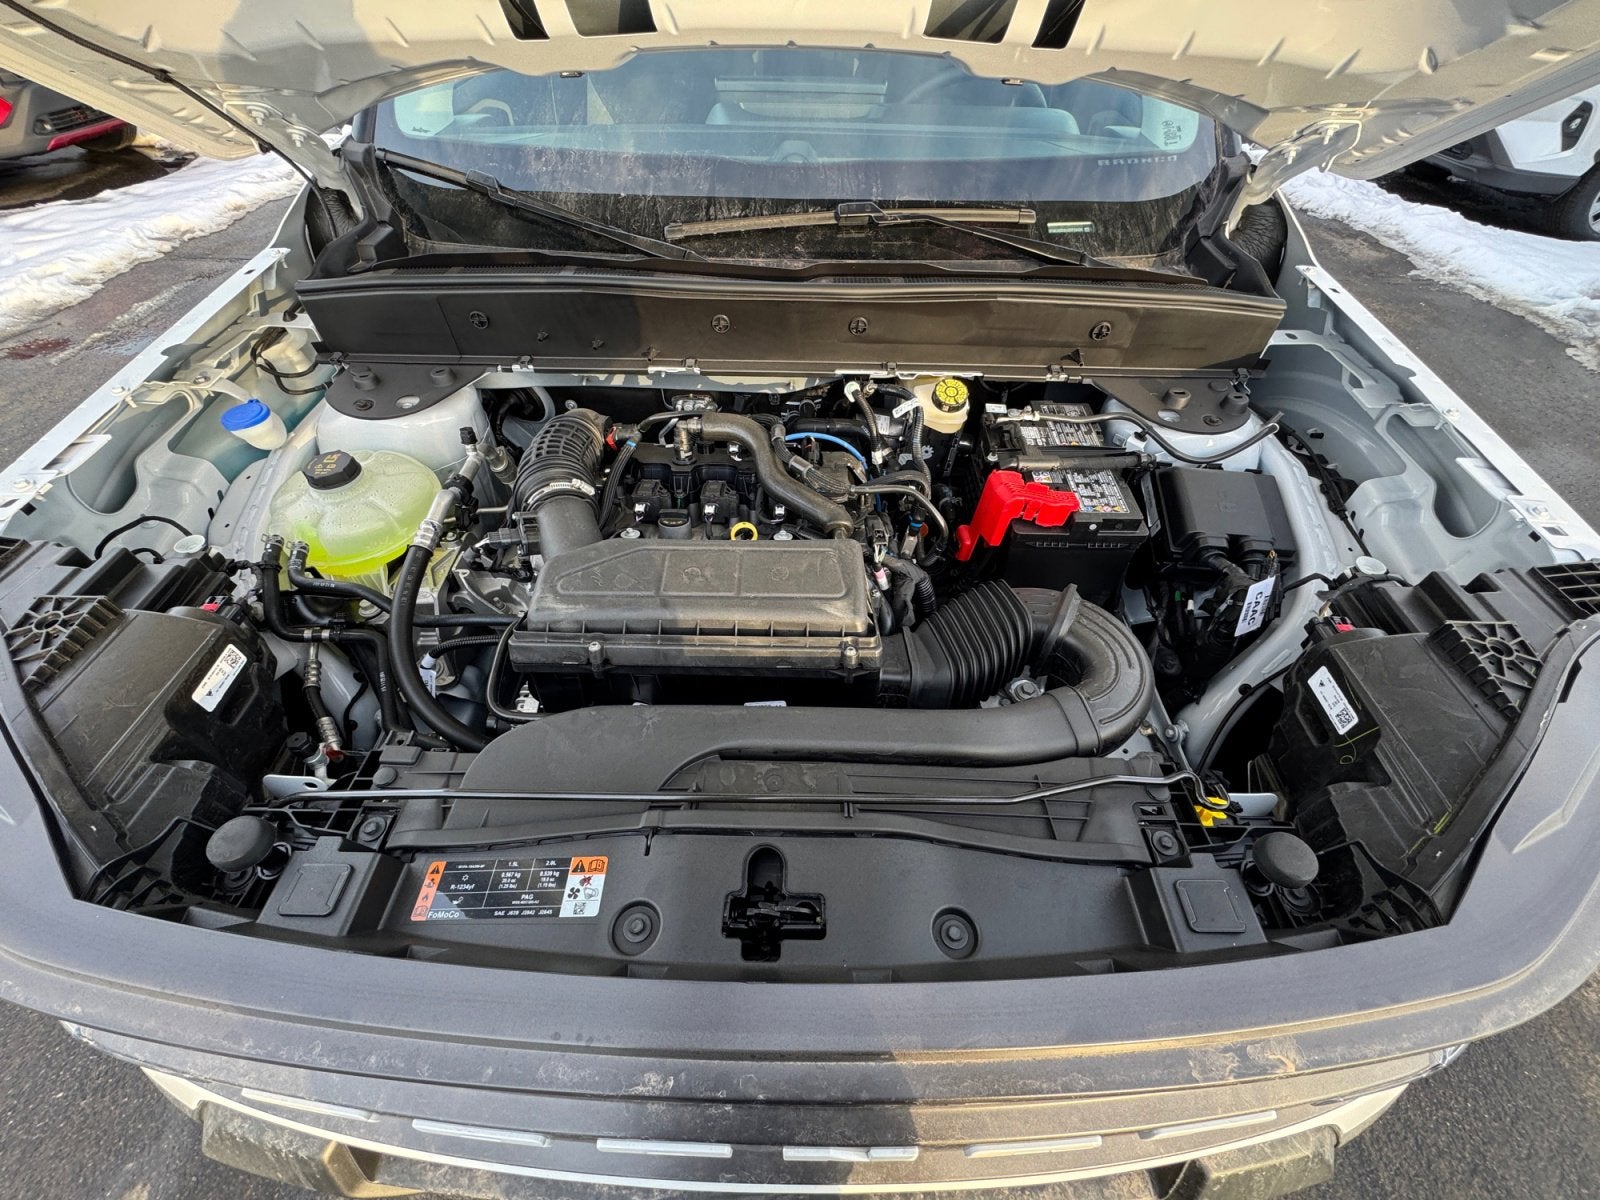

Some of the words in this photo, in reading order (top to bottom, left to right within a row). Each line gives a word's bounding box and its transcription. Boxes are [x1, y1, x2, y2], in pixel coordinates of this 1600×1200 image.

[1247, 590, 1264, 627] CAAC
[514, 871, 522, 879] kg
[552, 870, 560, 878] kg
[449, 883, 476, 891] R-1234yf
[427, 910, 460, 919] FoMoCo
